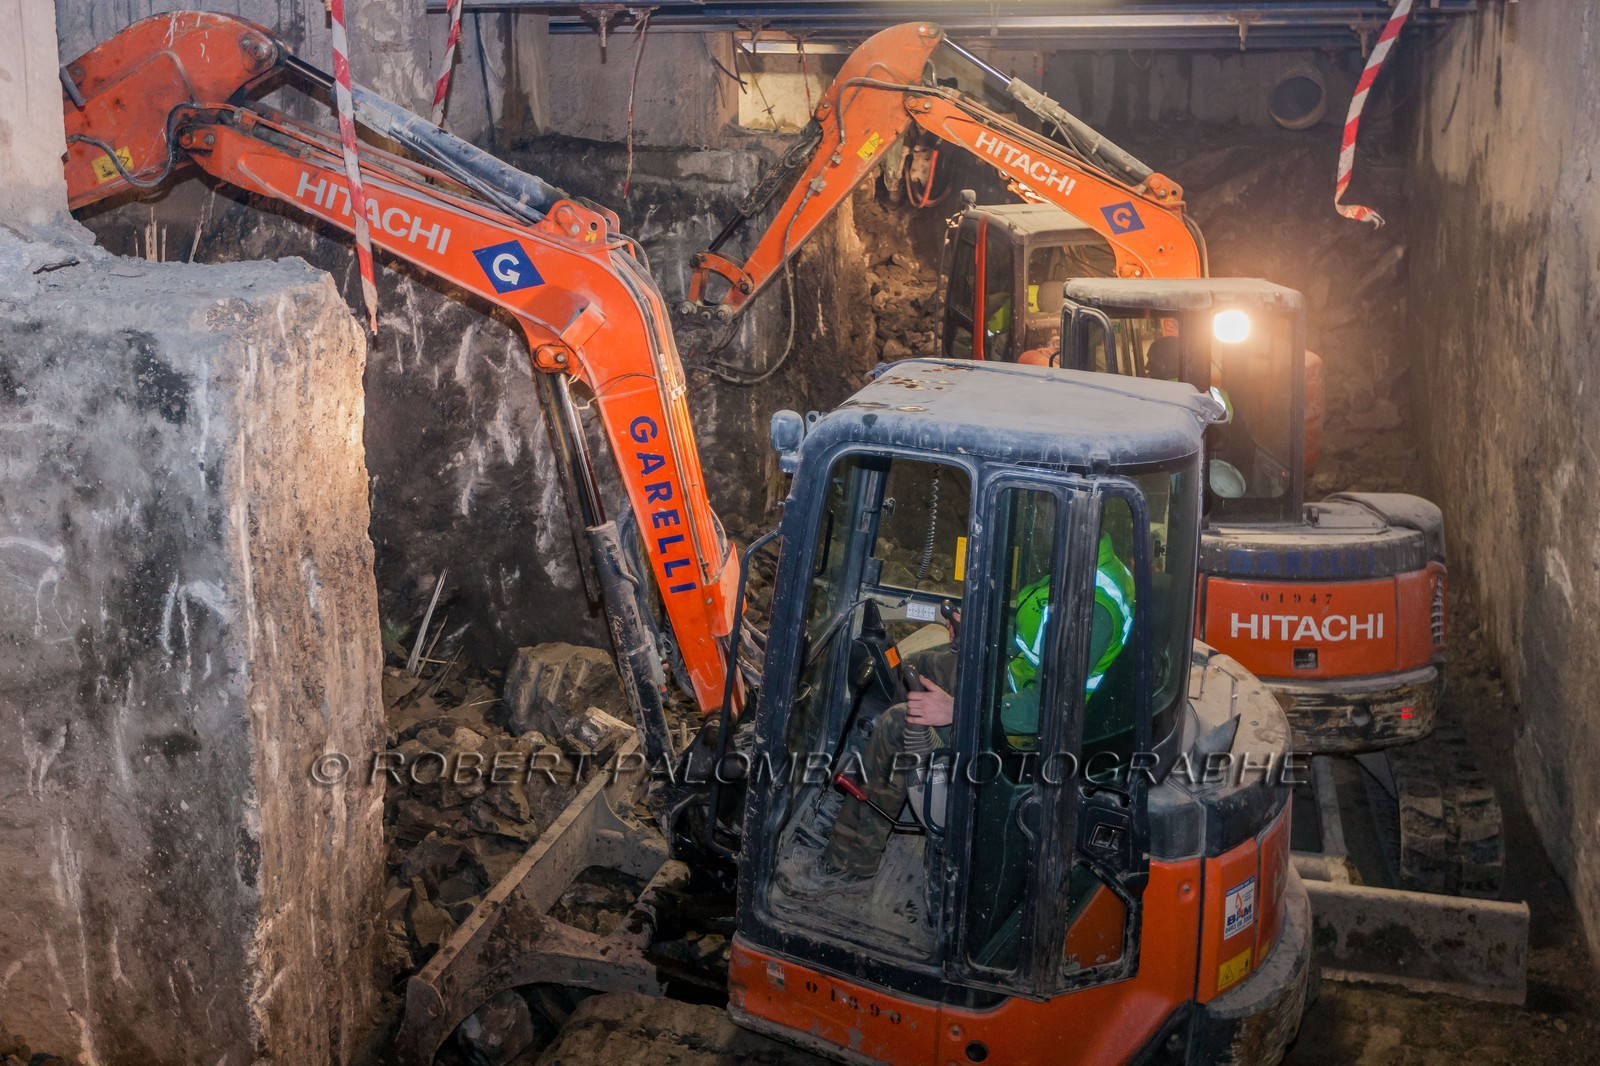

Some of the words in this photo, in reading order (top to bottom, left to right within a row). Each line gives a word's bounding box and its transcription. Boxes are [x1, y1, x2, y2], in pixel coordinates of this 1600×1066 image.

[974, 131, 1077, 196] HITACHI
[296, 171, 451, 255] HITACHI
[629, 415, 697, 594] GARELLI
[1260, 592, 1332, 604] 01947
[1230, 612, 1384, 642] HITACHI
[1226, 903, 1252, 927] BAM
